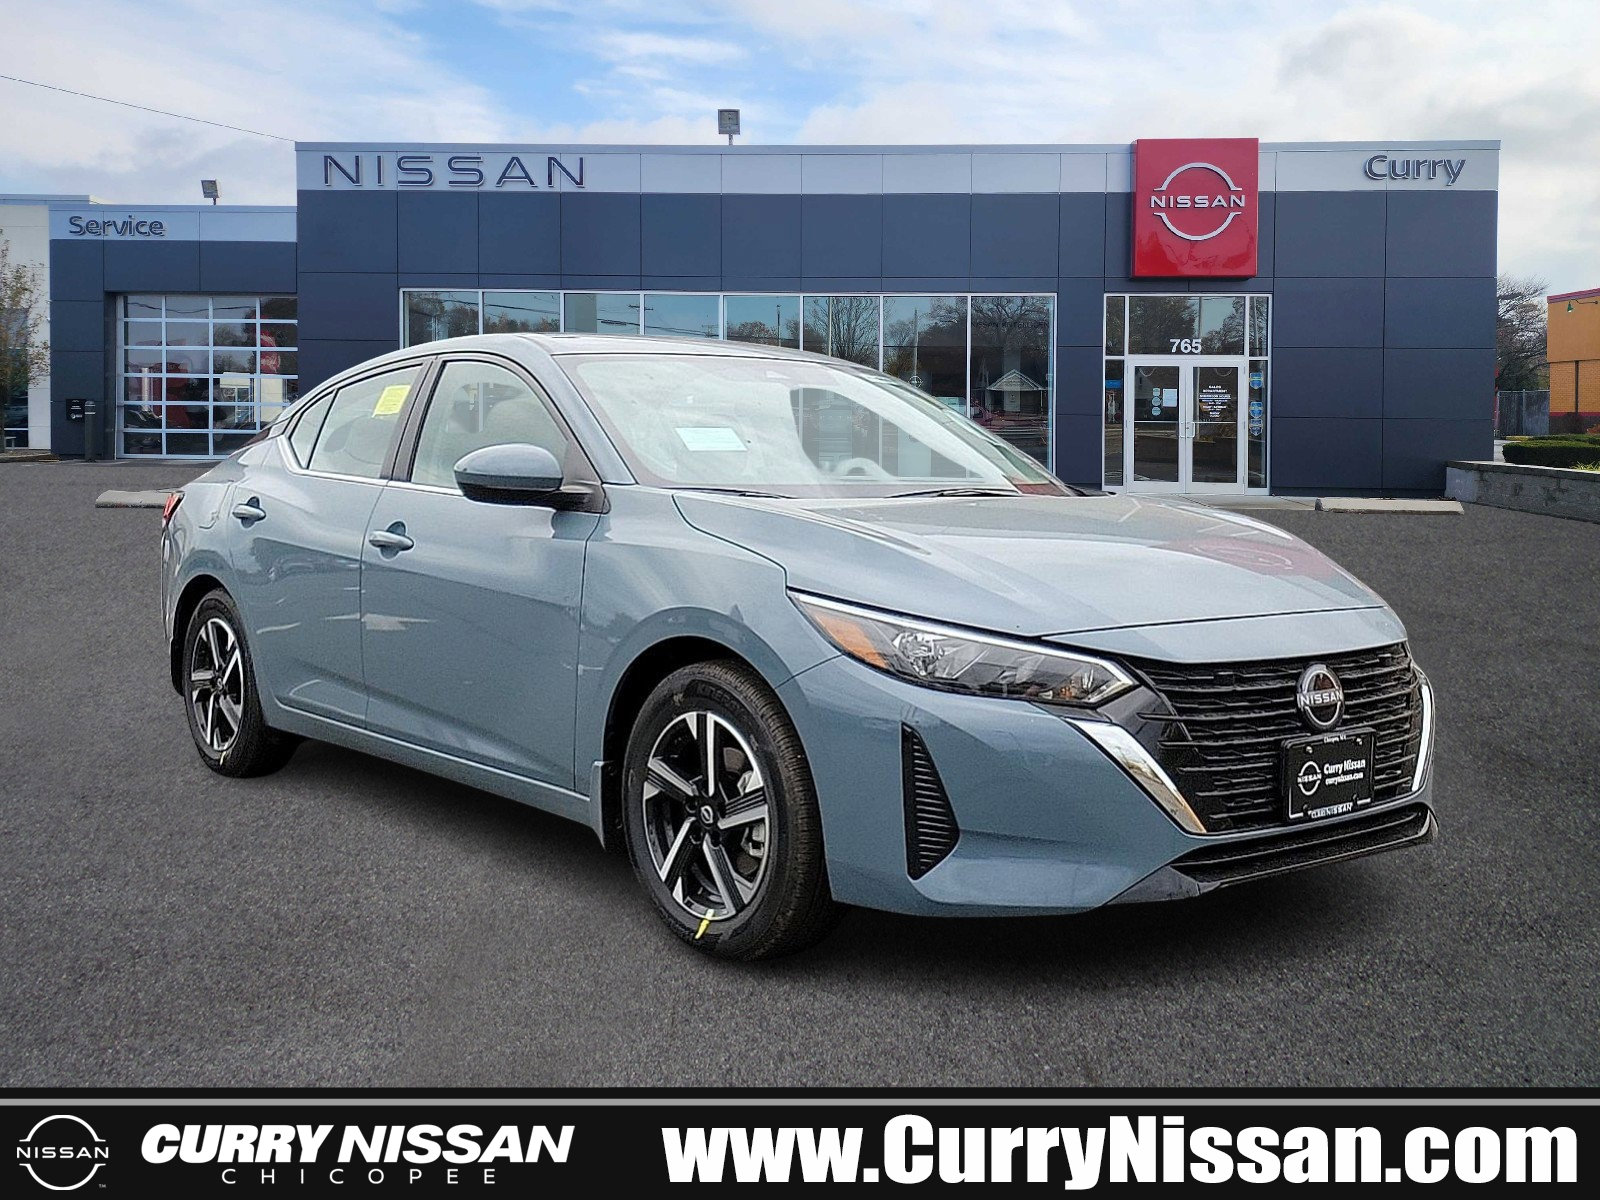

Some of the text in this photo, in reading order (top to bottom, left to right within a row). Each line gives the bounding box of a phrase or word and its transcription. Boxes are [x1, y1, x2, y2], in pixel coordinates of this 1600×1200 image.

[323, 155, 586, 187] NISSAN
[1364, 154, 1466, 187] Curry
[1150, 194, 1246, 208] NISSAN
[68, 214, 166, 237] Service
[1169, 338, 1202, 354] 765
[1300, 690, 1343, 706] NISSAN
[1323, 759, 1366, 775] Curry Nissan
[1297, 773, 1322, 783] NISSAN
